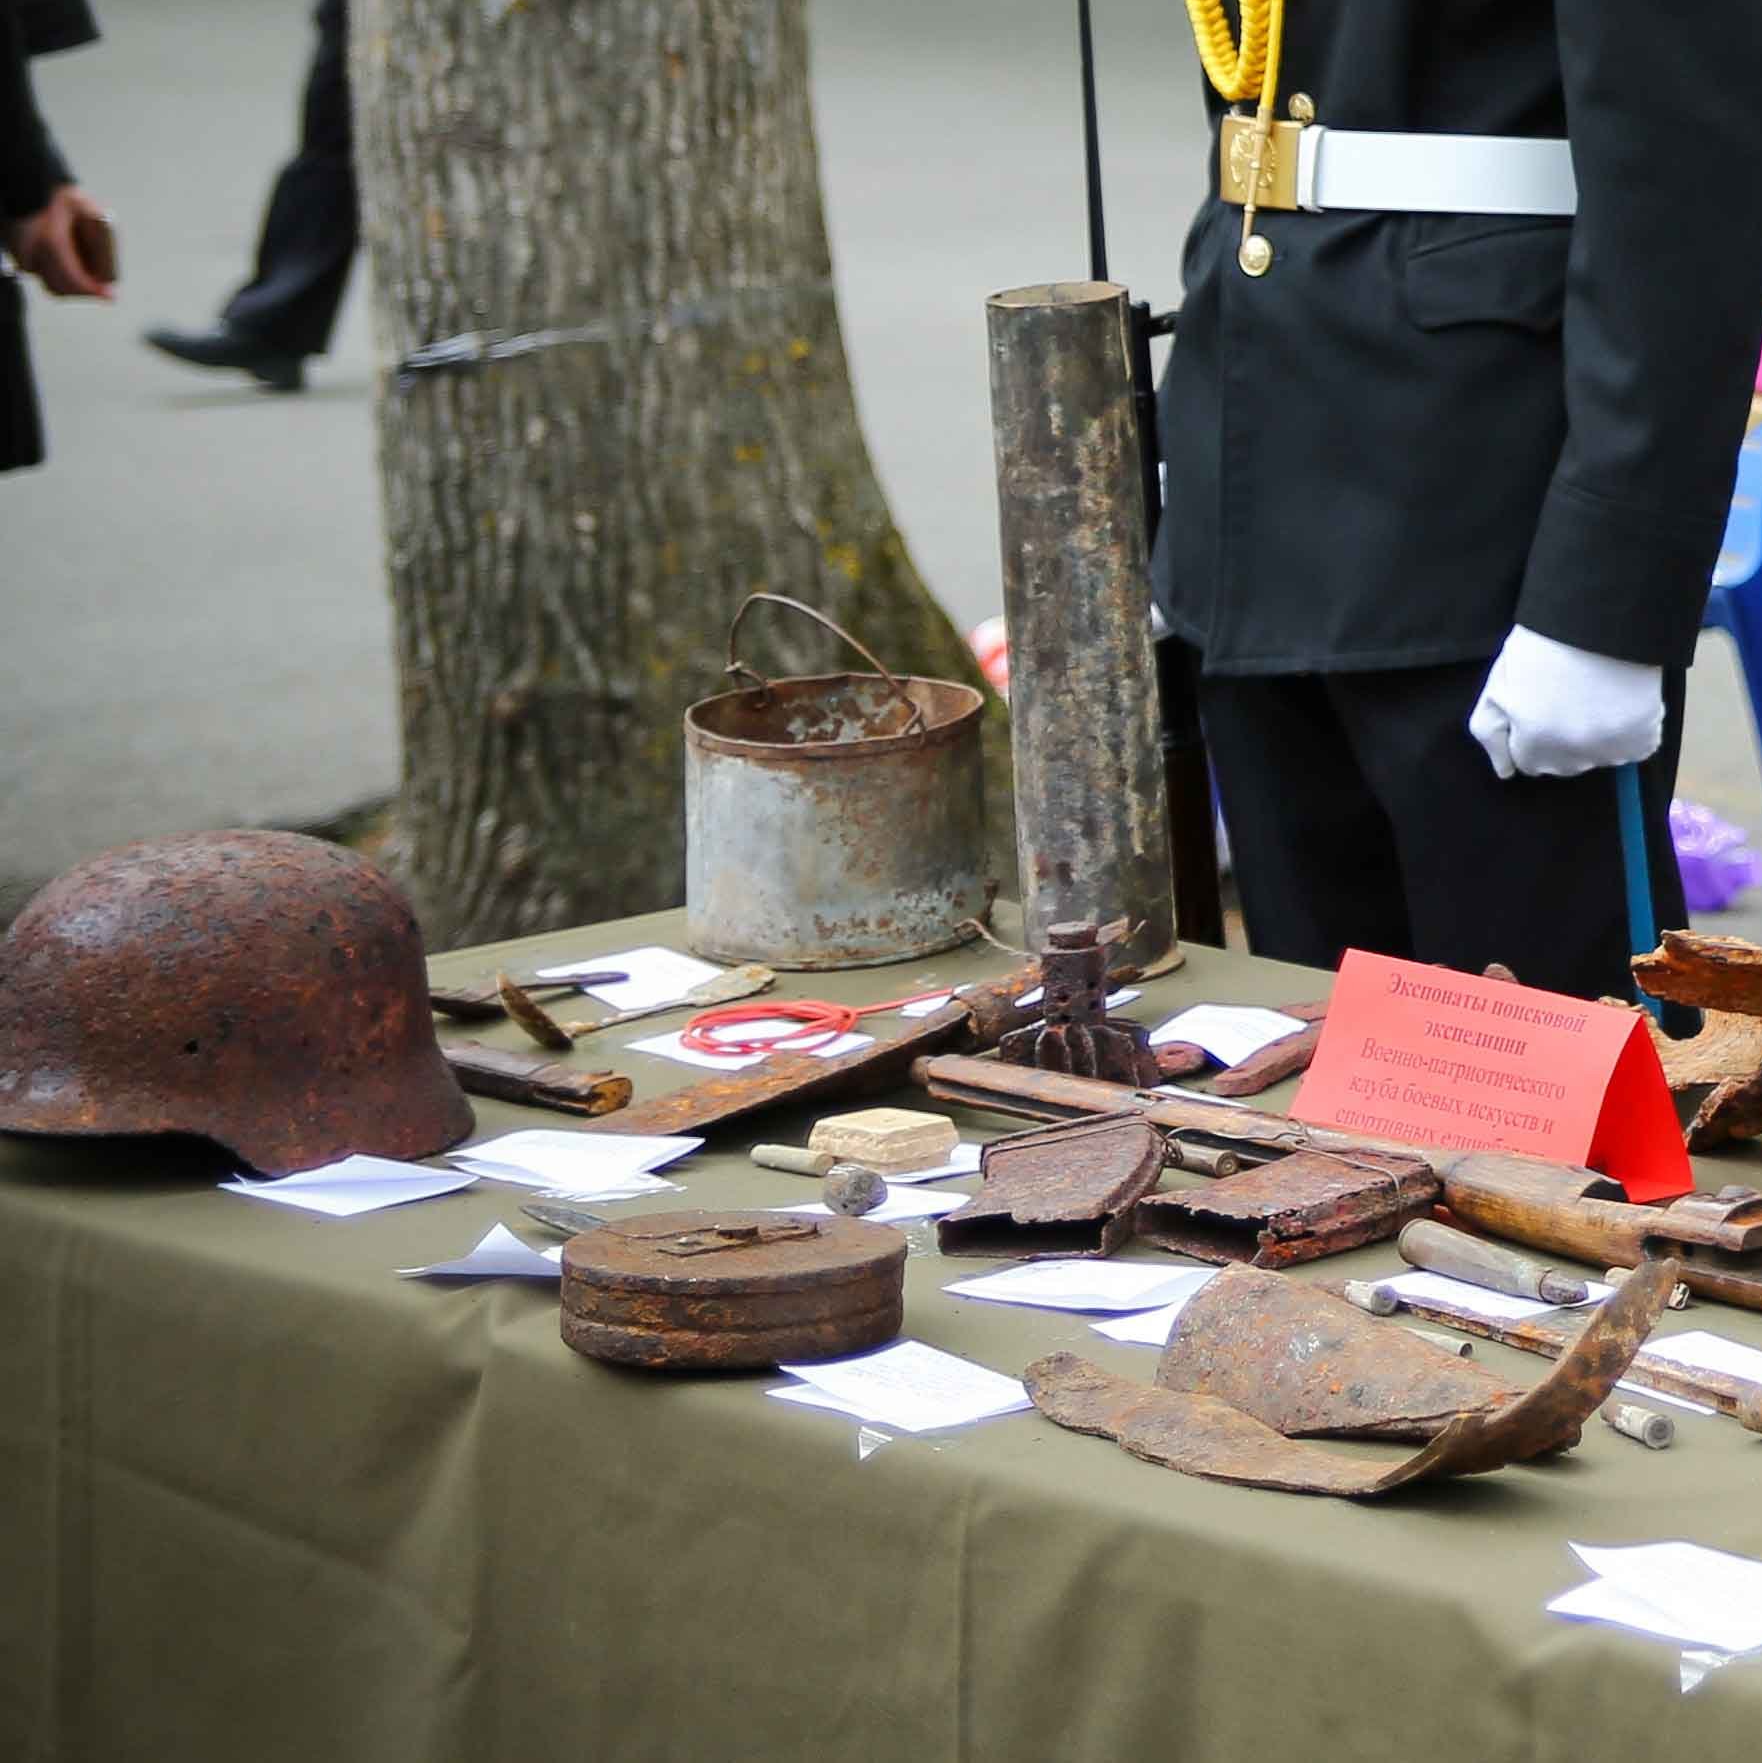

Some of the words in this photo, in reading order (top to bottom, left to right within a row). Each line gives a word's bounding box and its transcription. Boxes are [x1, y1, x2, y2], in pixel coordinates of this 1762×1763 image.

[1387, 971, 1488, 1013] Экспонаты
[1490, 998, 1588, 1034] поисковой
[1360, 1037, 1567, 1101] Военно-патриотического
[1423, 1020, 1528, 1057] экспедиции
[1335, 1108, 1436, 1144] спортивных
[1349, 1074, 1400, 1101] клуба
[1402, 1082, 1463, 1116] боевых
[1466, 1100, 1538, 1130] искусств
[1541, 1118, 1555, 1136] и
